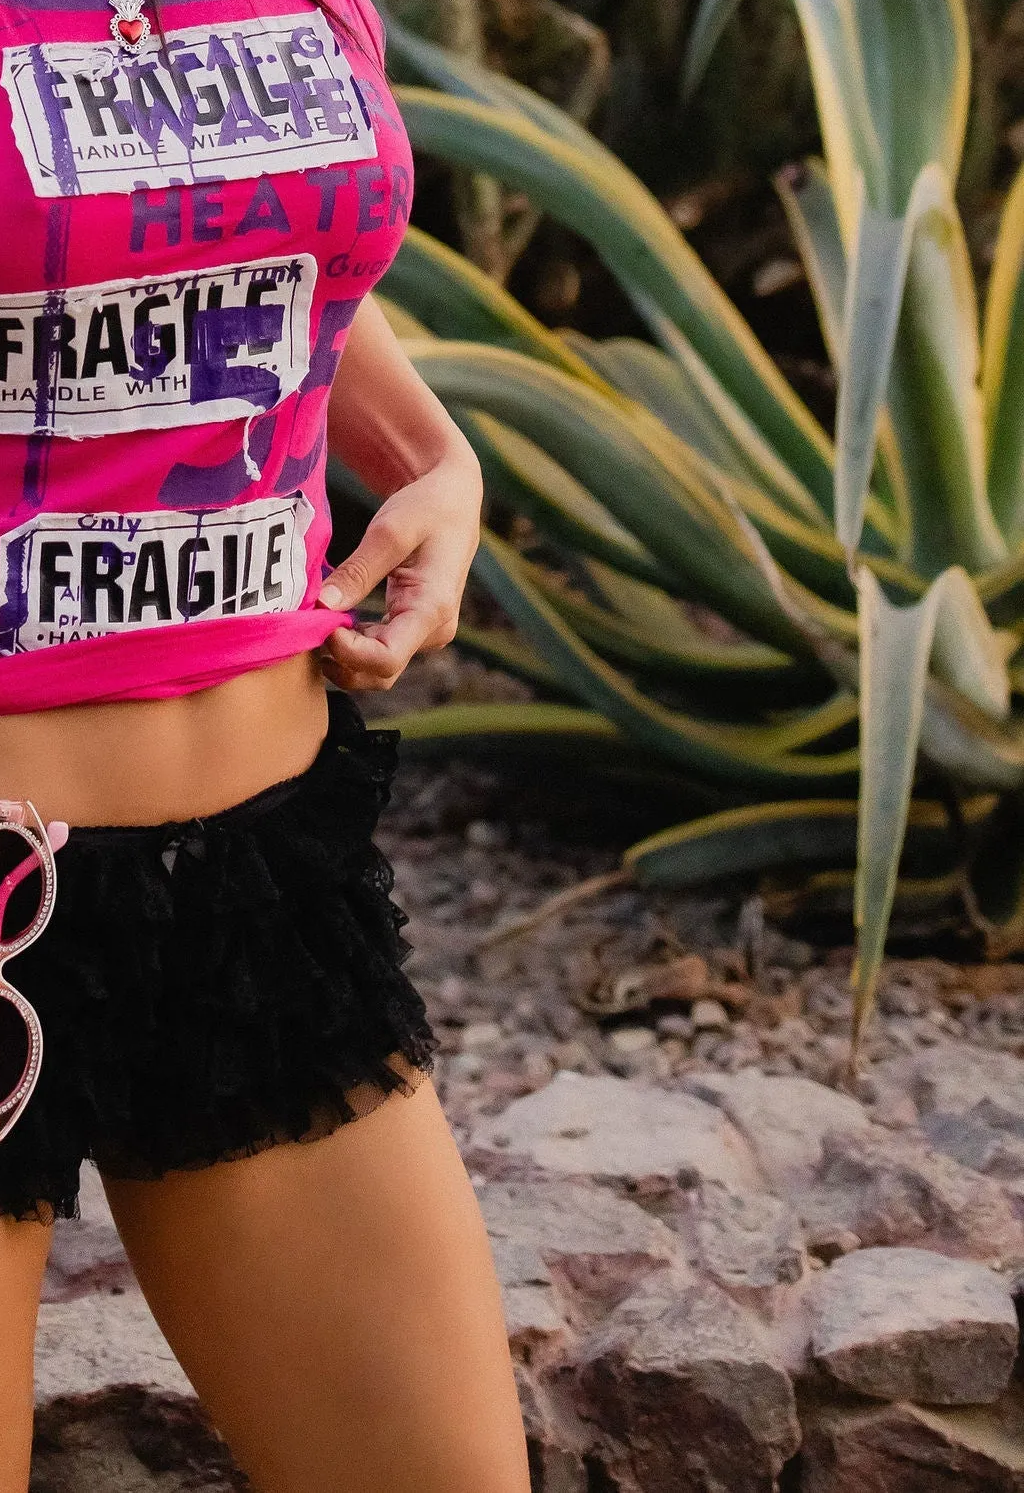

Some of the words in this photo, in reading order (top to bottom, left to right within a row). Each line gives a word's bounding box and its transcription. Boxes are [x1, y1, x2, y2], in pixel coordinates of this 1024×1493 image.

[33, 40, 322, 137] FRAGILE
[129, 164, 410, 253] HEATER
[125, 373, 187, 396] WITH
[77, 514, 142, 542] Only
[39, 522, 286, 624] FRAGILE
